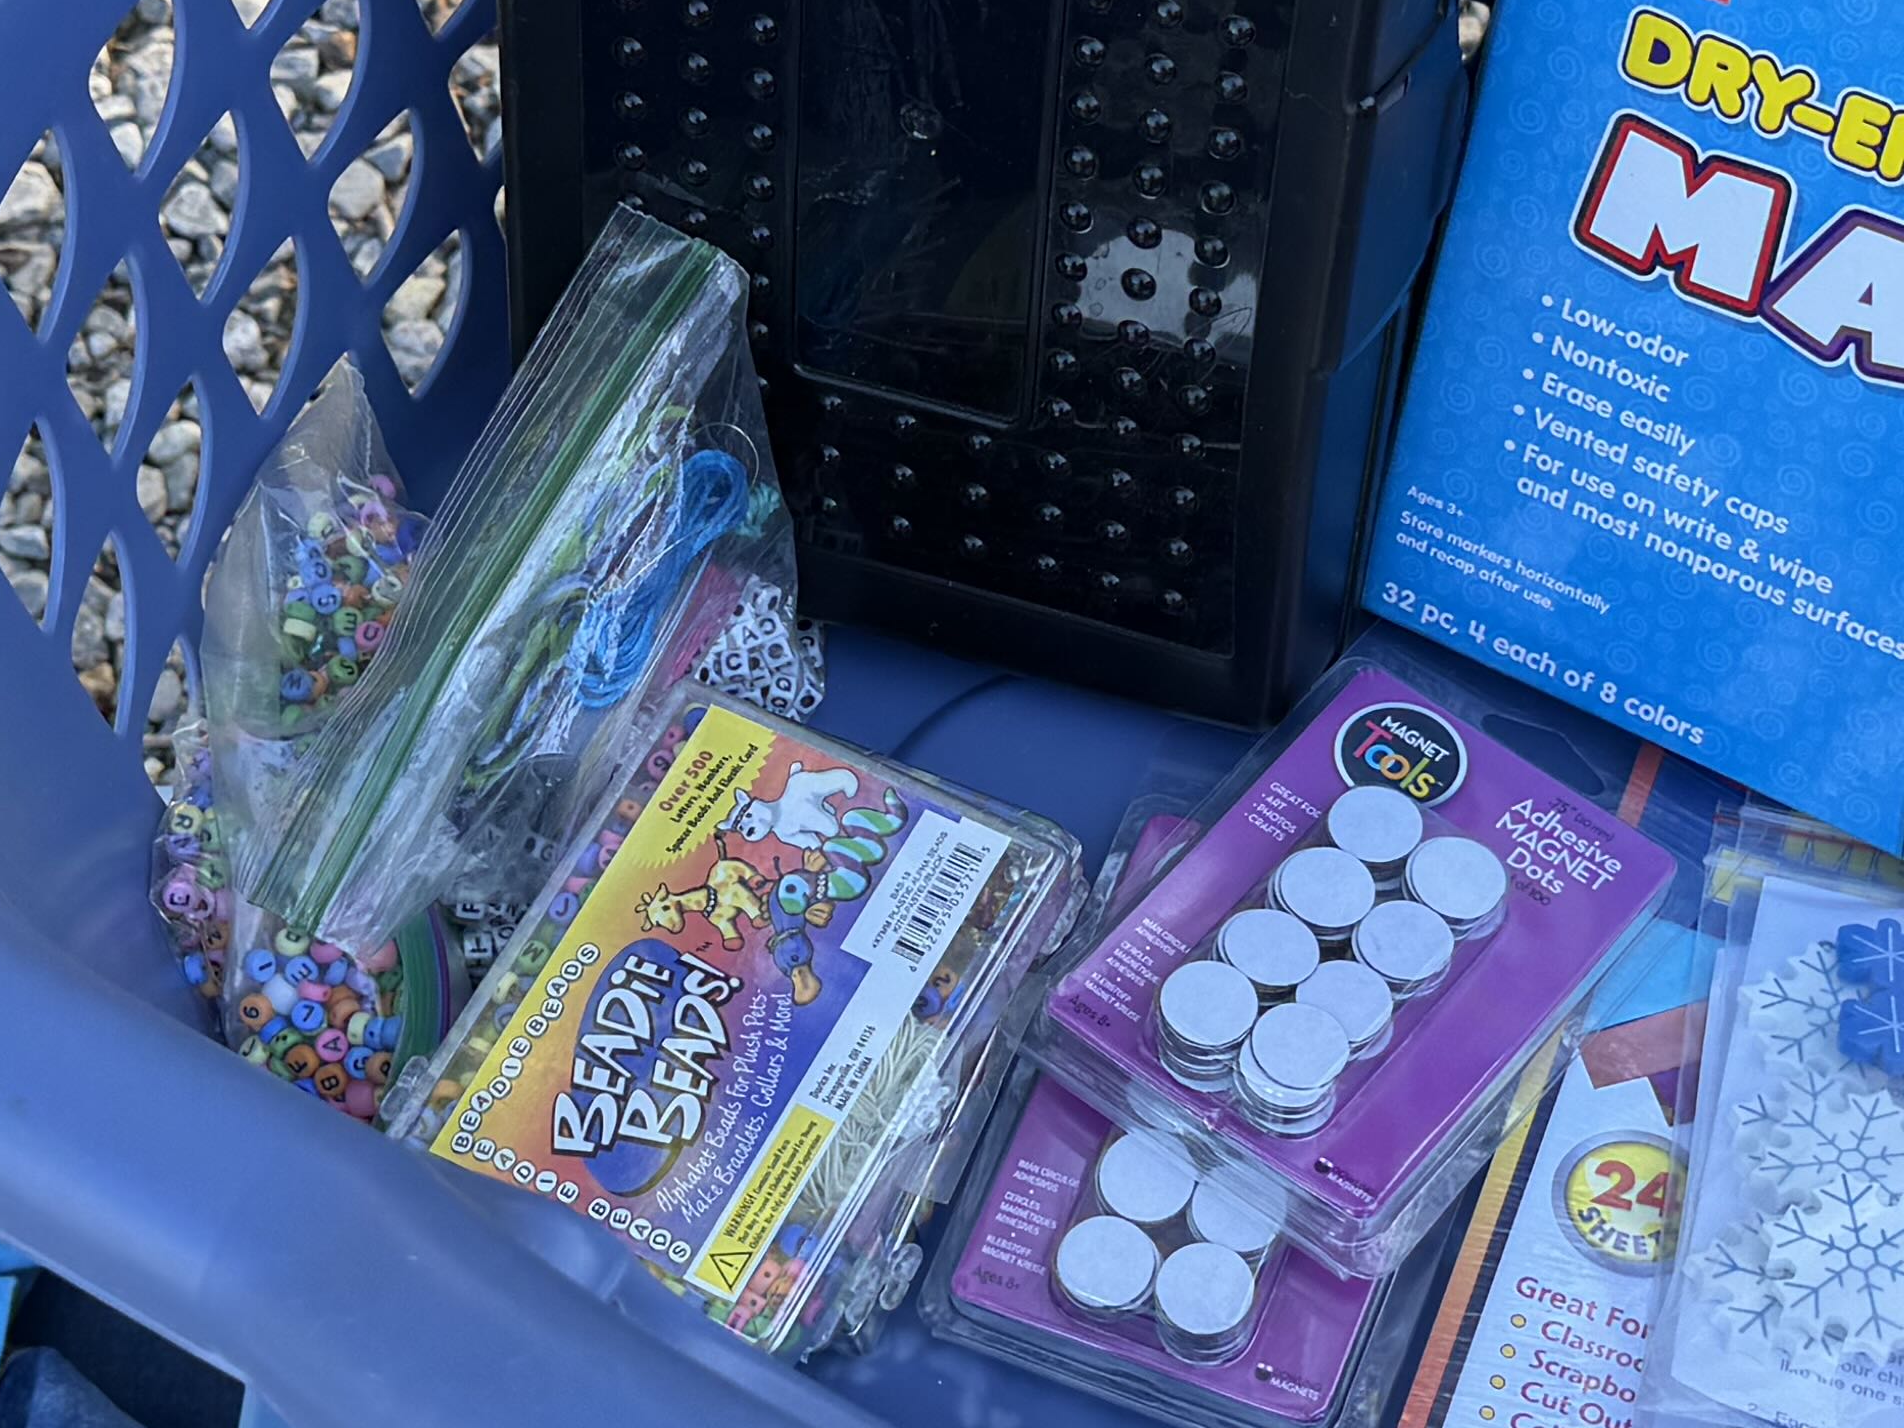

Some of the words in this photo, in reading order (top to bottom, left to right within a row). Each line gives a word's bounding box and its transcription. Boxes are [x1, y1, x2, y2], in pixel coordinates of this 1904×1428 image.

[1562, 298, 1689, 368] Low-odor
[1552, 336, 1670, 402] Nontoxic
[1542, 373, 1612, 418] Erase
[1620, 406, 1695, 456] easily
[1407, 485, 1443, 511] Ages
[1447, 502, 1464, 518] 3+
[1535, 407, 1628, 465] Vented
[1633, 453, 1719, 508] safety
[1726, 494, 1790, 535] caps
[1517, 475, 1568, 510] and
[1573, 501, 1638, 541] most
[1646, 532, 1785, 606] nonporous
[1523, 444, 1562, 475] For
[1572, 468, 1615, 500] use
[1623, 489, 1656, 517] on
[1664, 502, 1732, 551] write
[1739, 537, 1760, 563] &
[1769, 552, 1833, 596] wipe
[1396, 530, 1428, 554] and
[1430, 545, 1475, 576] recap
[1479, 569, 1519, 595] after
[1524, 587, 1554, 612] use.
[1401, 510, 1444, 539] Store
[1448, 532, 1511, 570] markers
[1516, 560, 1610, 615] horizontally
[1382, 582, 1415, 613] 32
[1421, 603, 1459, 636] pc,
[1468, 619, 1487, 644] 4
[1493, 631, 1556, 678] each
[1564, 664, 1595, 693] of
[1599, 681, 1617, 705] 8
[1624, 695, 1705, 746] colors
[1353, 720, 1436, 798] Tools
[1381, 716, 1450, 761] MAGNET
[658, 778, 692, 813] Over
[685, 750, 714, 780] 500
[1496, 811, 1615, 890] MAGNET
[1511, 799, 1623, 873] Adhesive
[1506, 847, 1565, 894] Dots
[526, 942, 601, 1038] BEADS
[770, 992, 793, 1035] More!
[619, 953, 741, 1144] BEADS!
[732, 1029, 761, 1081] Plush
[767, 1034, 790, 1053] &
[451, 1036, 532, 1154] BEADIE
[725, 1081, 751, 1102] For
[750, 1051, 785, 1110] Collars
[712, 1101, 743, 1147] Beads
[713, 1112, 770, 1186] Bracelets,
[656, 1148, 716, 1213] Alphabet
[682, 1183, 724, 1224] Make
[1590, 1160, 1679, 1217] 24
[588, 1197, 692, 1263] BEADS
[1515, 1275, 1599, 1323] Great
[1520, 1380, 1570, 1417] Cut
[1851, 1382, 1887, 1402] one
